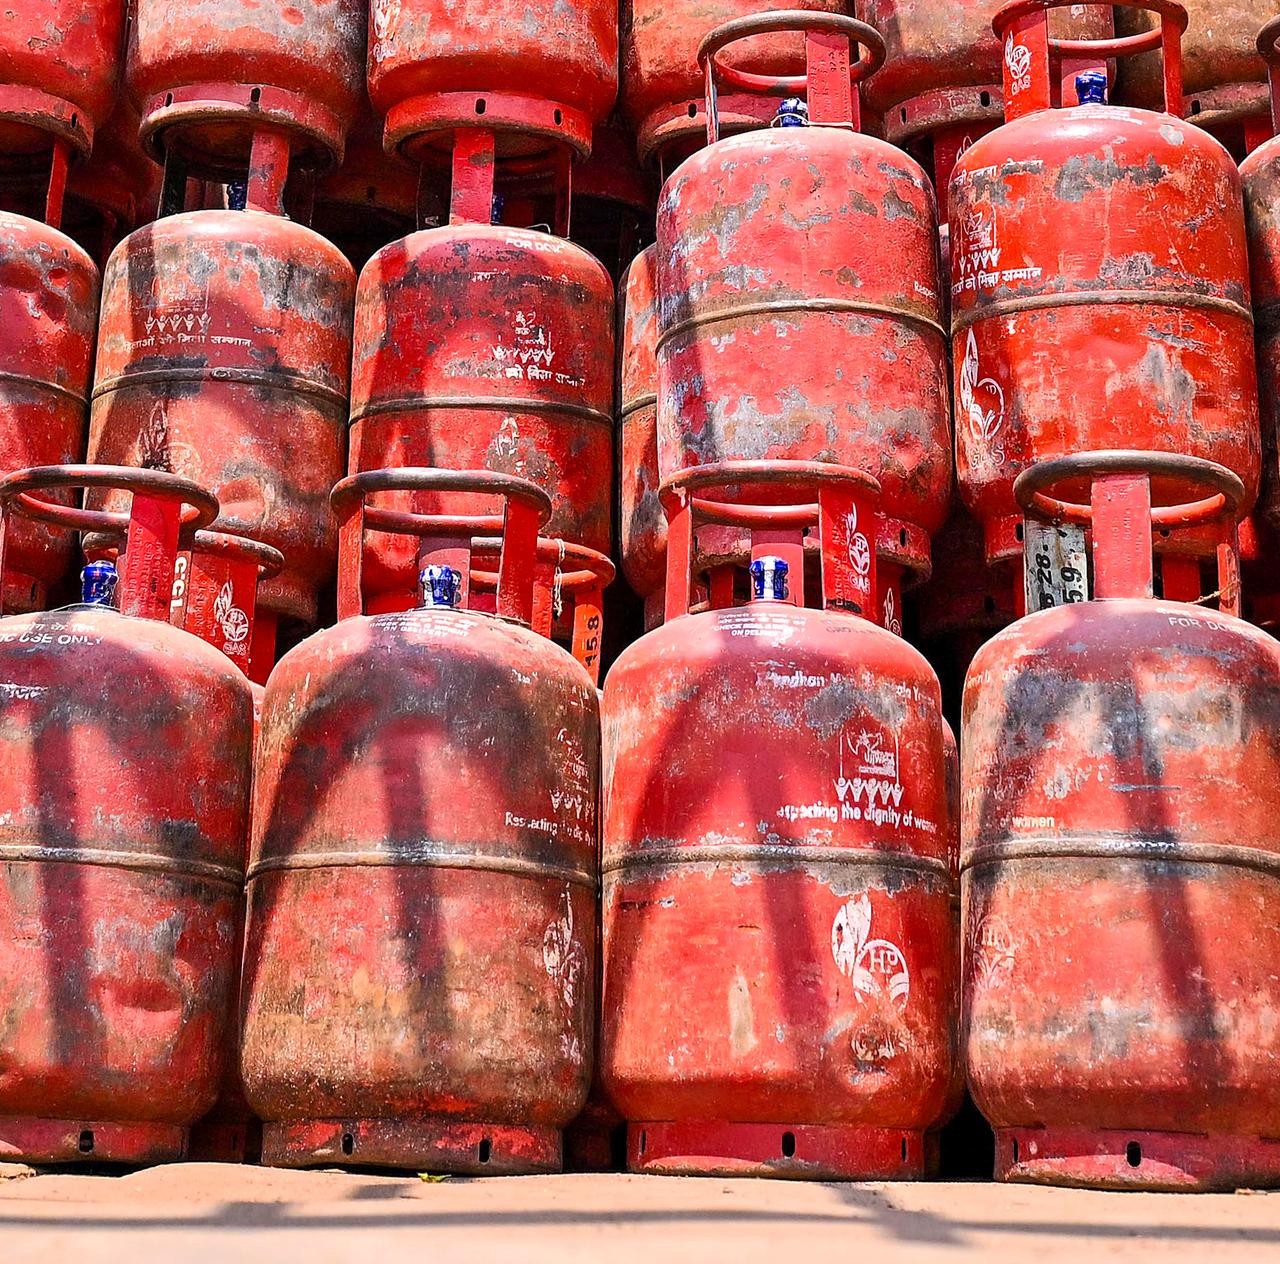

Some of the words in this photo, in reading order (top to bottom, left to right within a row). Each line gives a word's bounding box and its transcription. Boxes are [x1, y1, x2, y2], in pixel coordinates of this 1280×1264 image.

[1002, 267, 1043, 282] सम्मान
[1169, 617, 1201, 628] FOR
[56, 634, 104, 646] ONLY
[841, 801, 863, 820] the
[863, 802, 902, 830] dignity
[903, 811, 913, 826] of
[1012, 815, 1056, 828] women
[869, 949, 899, 975] HP
